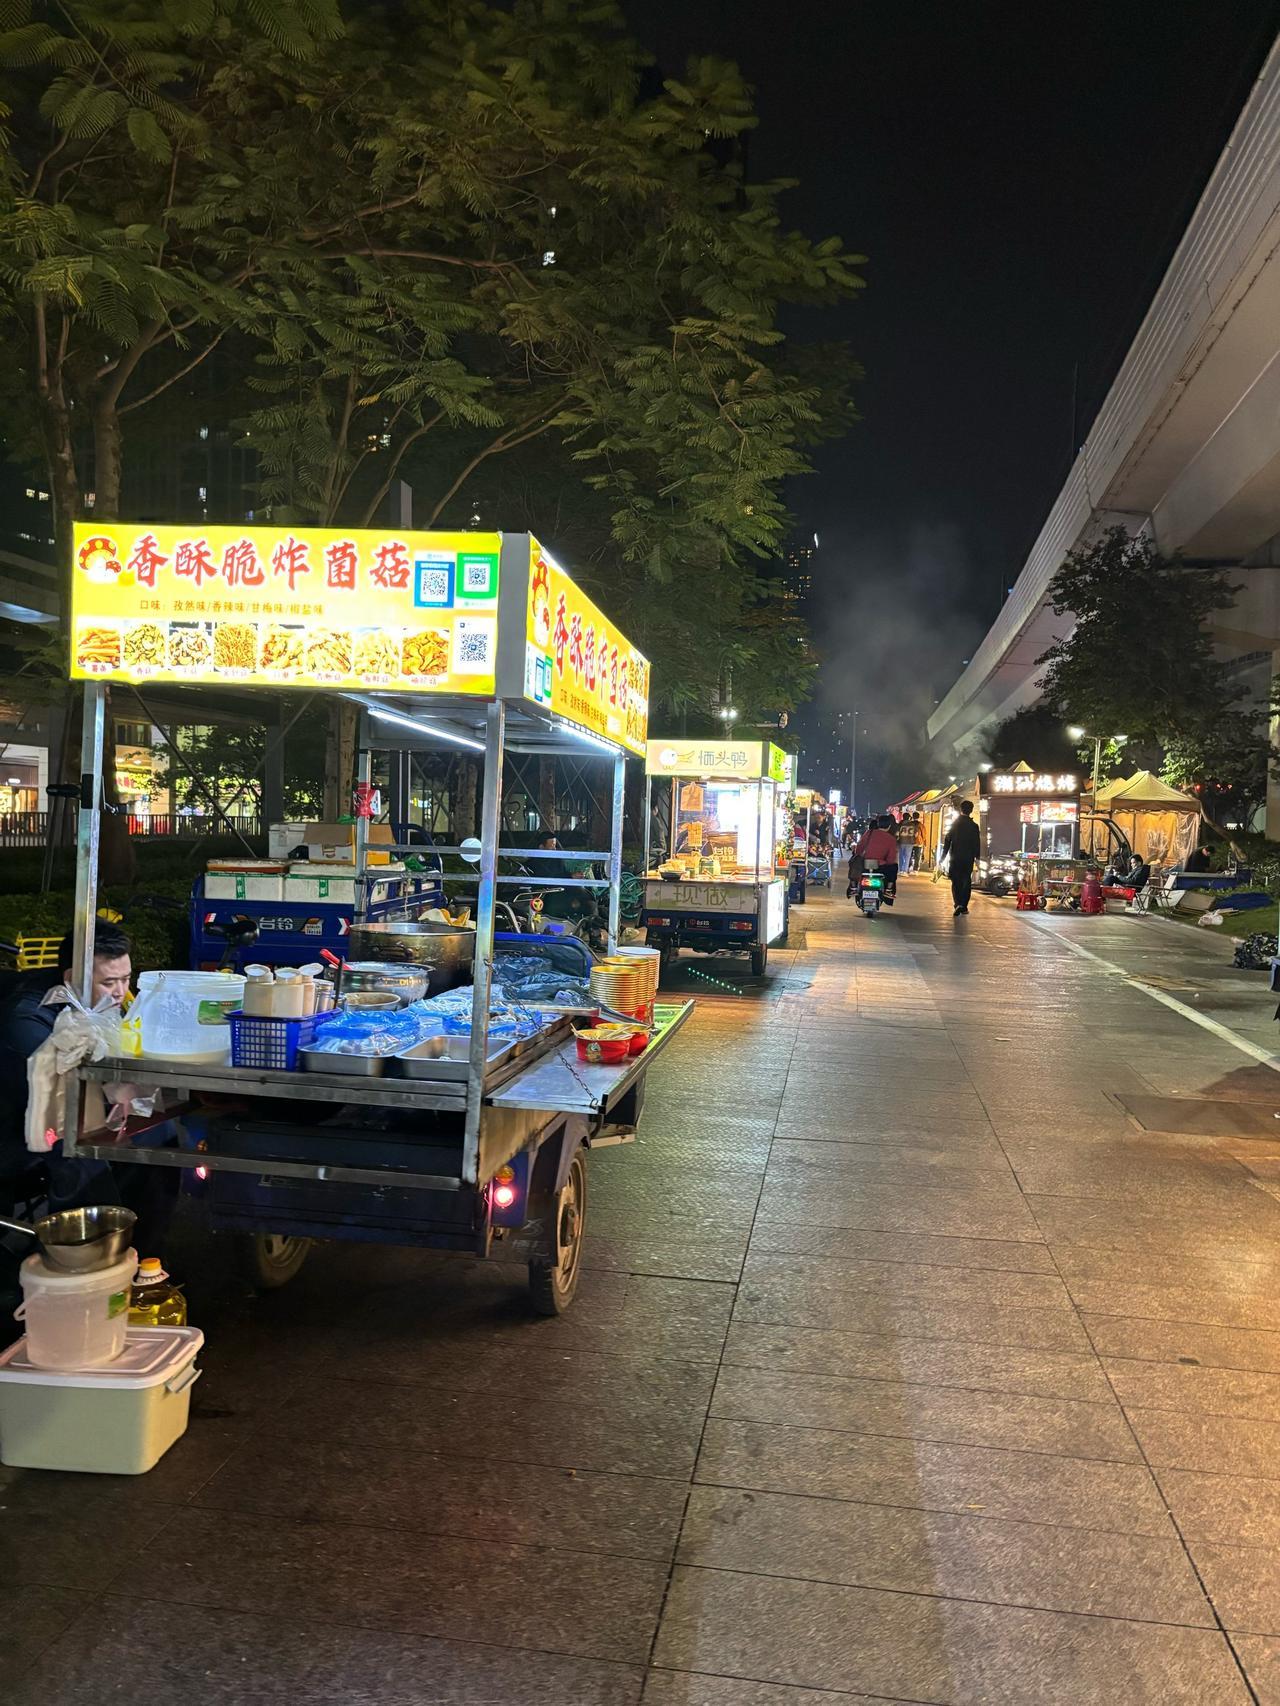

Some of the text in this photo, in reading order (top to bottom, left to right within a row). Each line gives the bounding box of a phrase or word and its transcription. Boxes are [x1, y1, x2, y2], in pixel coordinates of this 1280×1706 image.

[127, 535, 411, 590] 香酥脆炸菌菇
[673, 885, 729, 906] 现做
